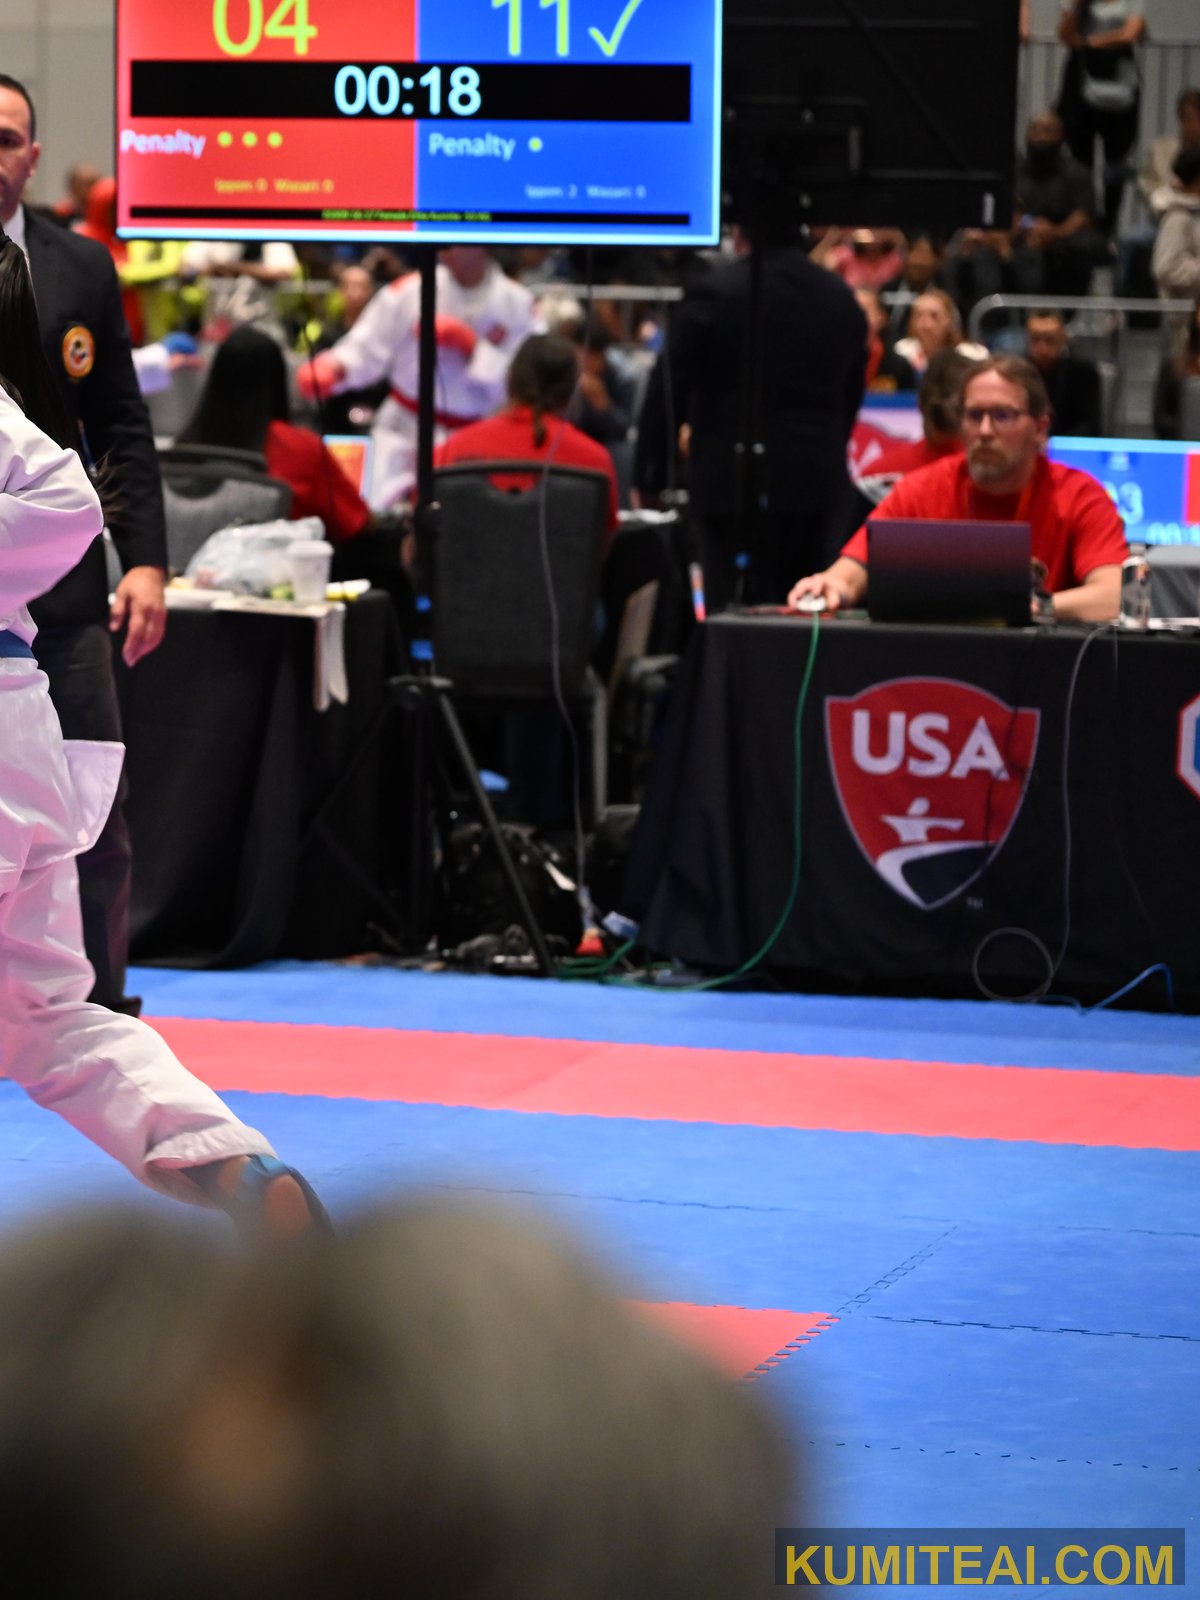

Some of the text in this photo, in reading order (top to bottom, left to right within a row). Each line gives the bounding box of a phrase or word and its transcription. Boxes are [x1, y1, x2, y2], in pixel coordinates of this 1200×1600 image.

[213, 0, 318, 57] 04
[491, 0, 570, 57] 11
[334, 65, 481, 116] 00:18
[120, 129, 206, 158] Penalty
[429, 132, 516, 161] Penalty
[852, 709, 1010, 781] USA
